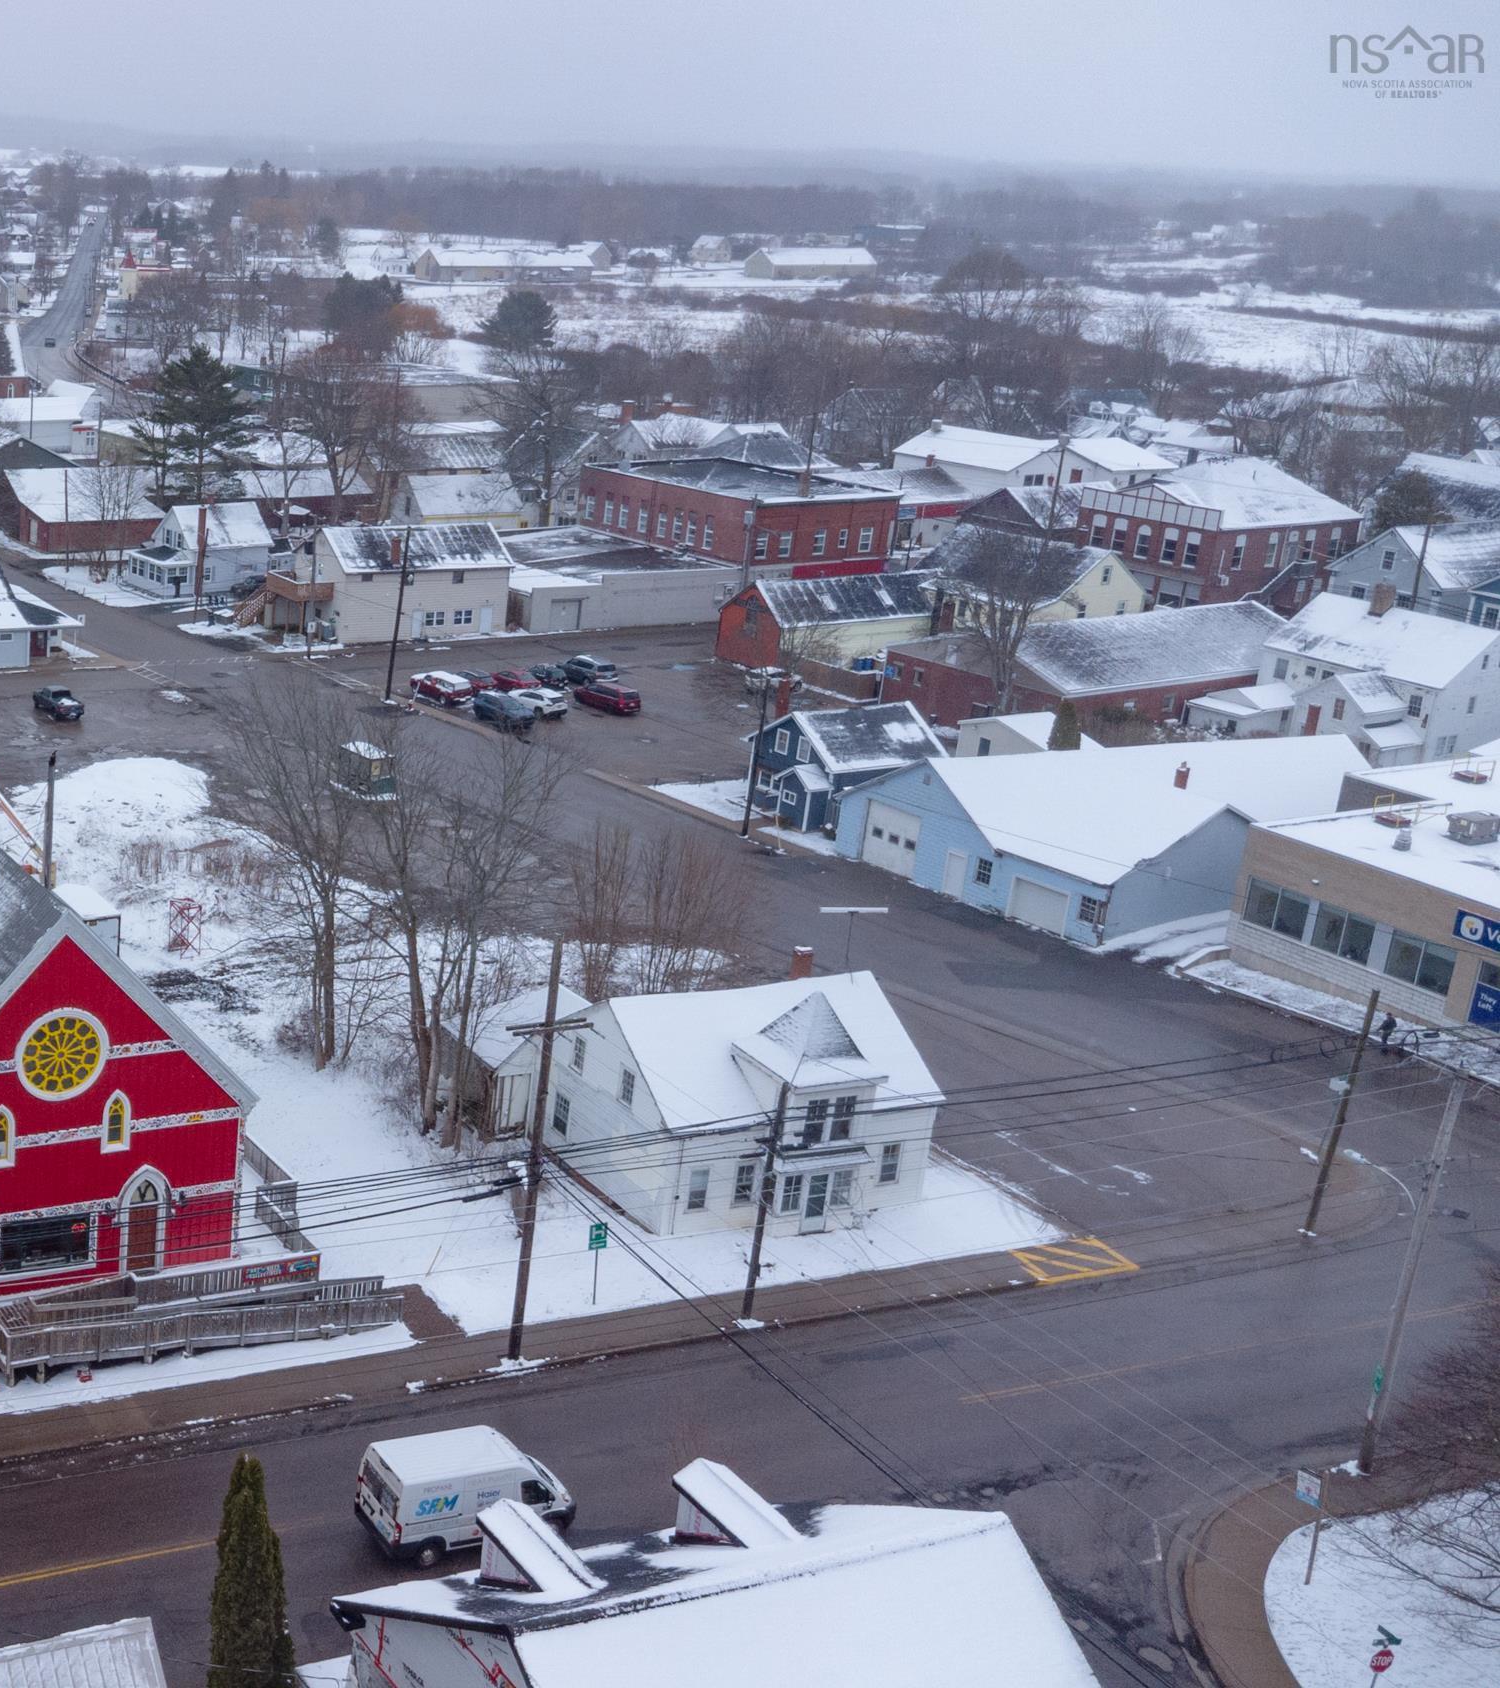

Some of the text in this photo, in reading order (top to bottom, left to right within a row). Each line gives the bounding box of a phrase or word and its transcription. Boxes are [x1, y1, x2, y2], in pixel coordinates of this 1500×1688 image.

[1480, 993, 1498, 1006] They
[592, 1225, 605, 1240] H
[477, 1490, 501, 1499] Haier
[1371, 1655, 1393, 1666] STOP
